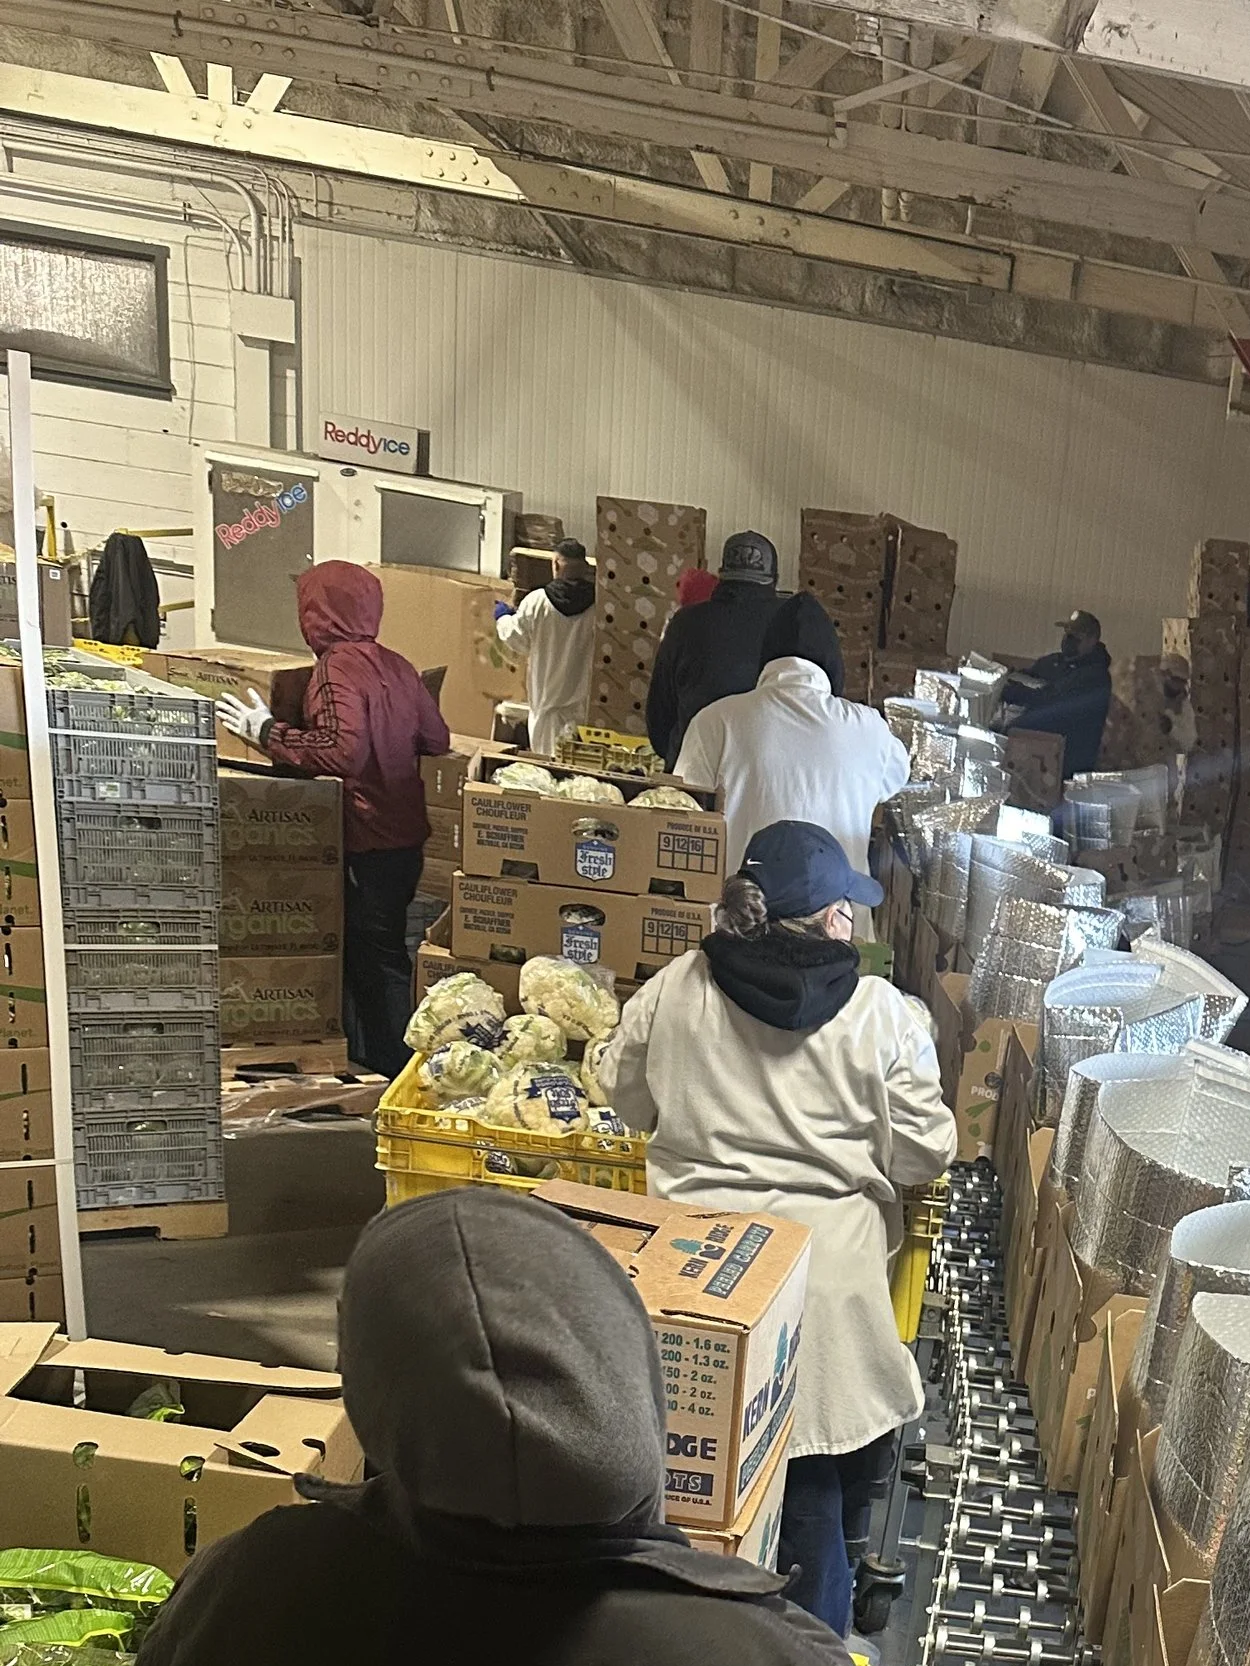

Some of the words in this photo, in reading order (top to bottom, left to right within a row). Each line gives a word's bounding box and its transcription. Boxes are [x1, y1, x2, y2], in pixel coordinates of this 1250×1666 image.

[471, 797, 532, 813] CAULIFLOWER
[247, 808, 312, 823] ARTISAN
[476, 807, 527, 821] CHOUFLEUR
[663, 836, 671, 848] 9
[675, 837, 688, 850] 12
[690, 839, 702, 852] 16
[578, 850, 612, 866] Fresh
[581, 865, 608, 878] style
[459, 882, 518, 898] CAULIFLOWER
[250, 900, 313, 913] ARTISAN
[463, 892, 513, 906] CHOUFLEUR
[647, 921, 655, 933] 9
[660, 923, 672, 936] 12
[675, 925, 686, 937] 16
[564, 934, 598, 950] Fresh
[252, 988, 314, 1001] ARTISAN
[678, 1257, 708, 1279] KERN
[707, 1262, 744, 1296] PEELED
[735, 1224, 770, 1263] CARROTS
[661, 1333, 683, 1346] 200
[693, 1337, 711, 1350] 1.6
[714, 1343, 730, 1354] oz.
[661, 1349, 682, 1363] 200
[692, 1354, 710, 1367] 1.3
[712, 1359, 729, 1369] oz.
[690, 1370, 698, 1381] 2
[701, 1374, 717, 1384] oz.
[666, 1383, 680, 1395] 00
[689, 1387, 697, 1398] 2
[700, 1390, 716, 1400] oz.
[687, 1403, 696, 1414] 4
[698, 1406, 715, 1417] oz.
[666, 1432, 717, 1461] DGE
